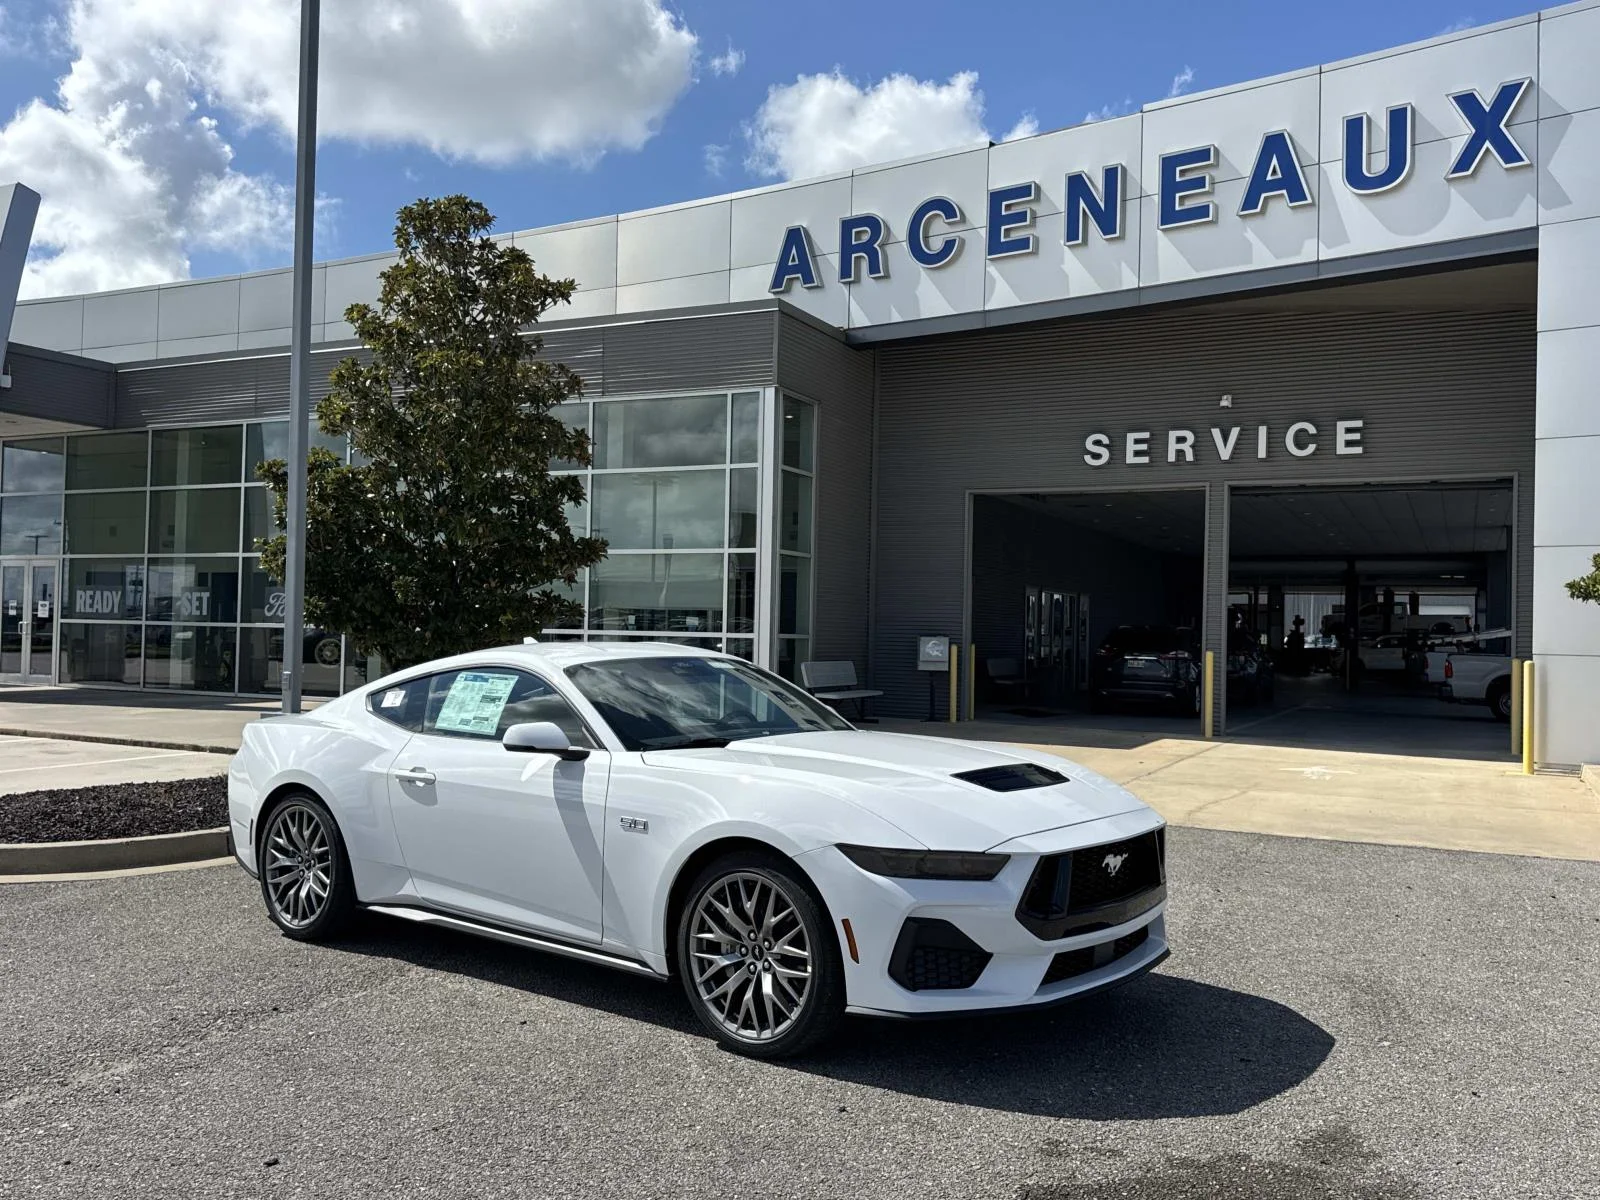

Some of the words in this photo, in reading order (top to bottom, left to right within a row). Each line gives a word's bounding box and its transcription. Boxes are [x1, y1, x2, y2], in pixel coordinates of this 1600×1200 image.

[768, 76, 1533, 294] ARCENEAUX
[1083, 419, 1364, 467] SERVICE
[75, 590, 123, 614] READY
[181, 591, 210, 616] SET
[264, 592, 286, 617] Fo
